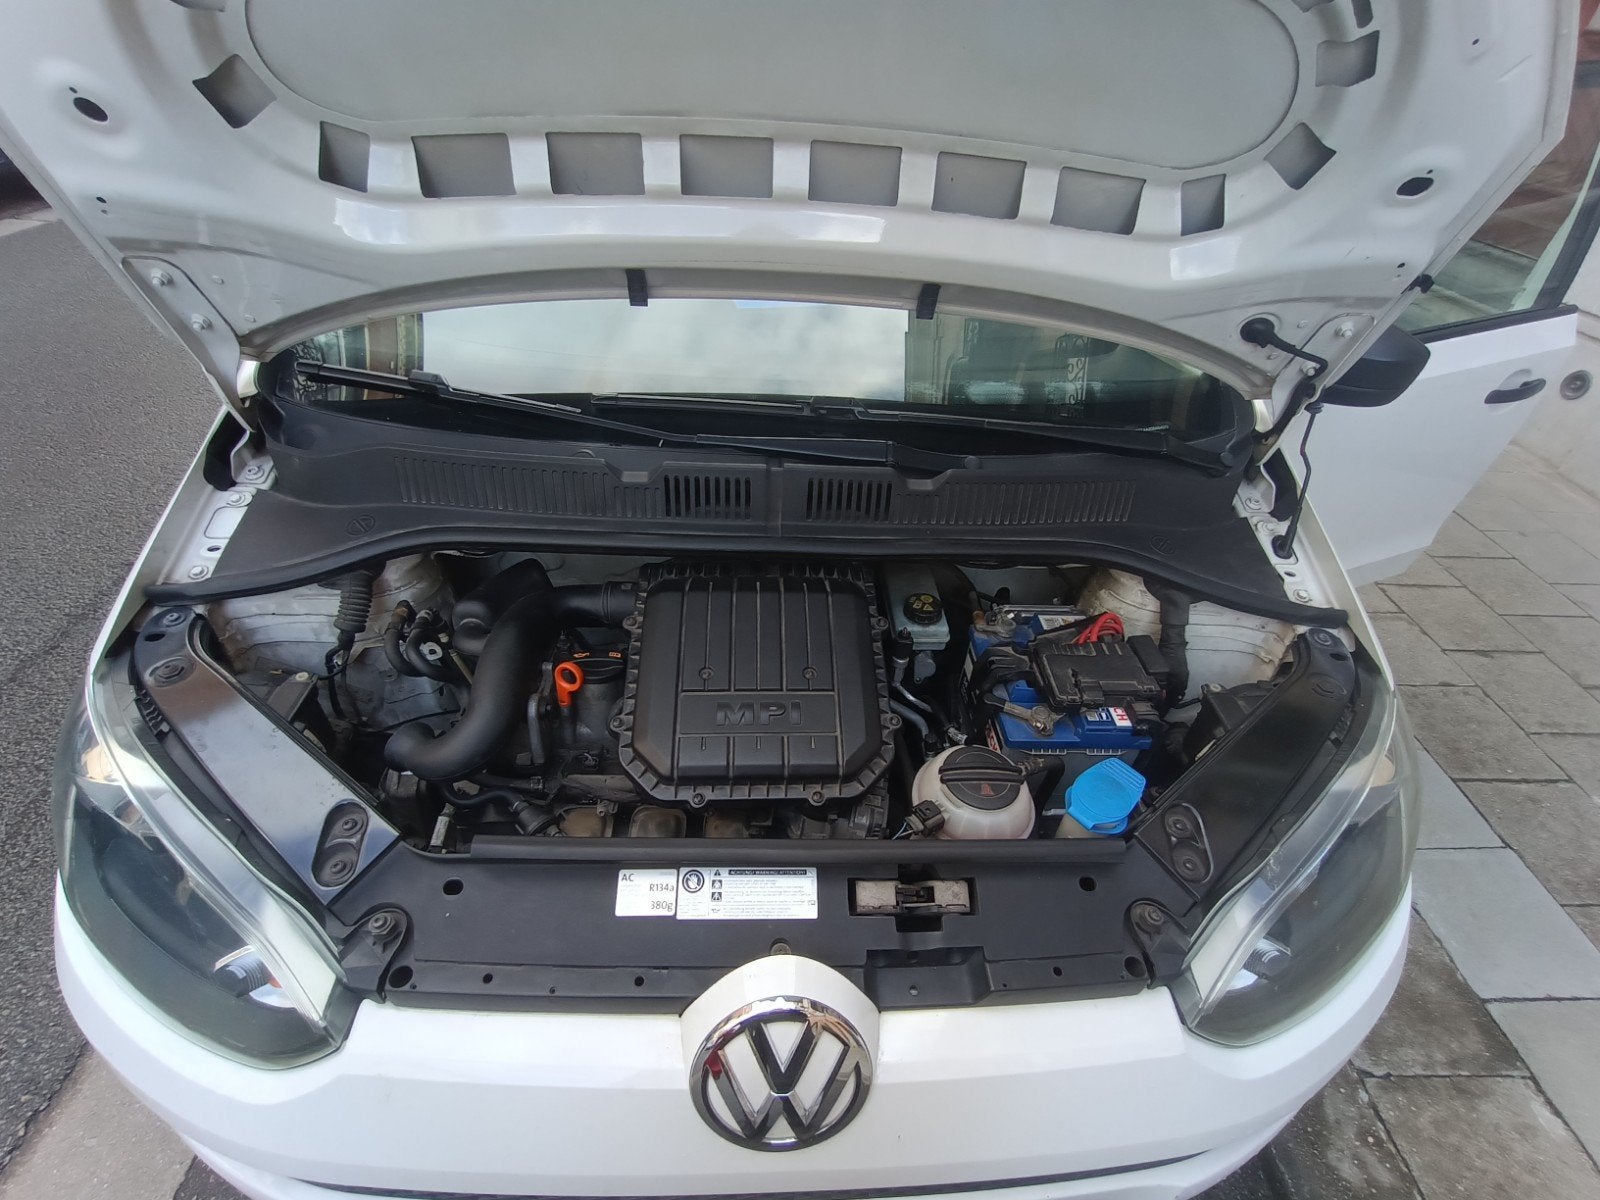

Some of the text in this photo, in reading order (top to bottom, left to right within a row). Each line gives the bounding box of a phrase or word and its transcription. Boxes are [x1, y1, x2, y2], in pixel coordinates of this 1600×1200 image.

[715, 700, 802, 726] MPI
[621, 873, 635, 882] AC
[649, 883, 675, 892] R134a
[650, 901, 674, 912] 380g
